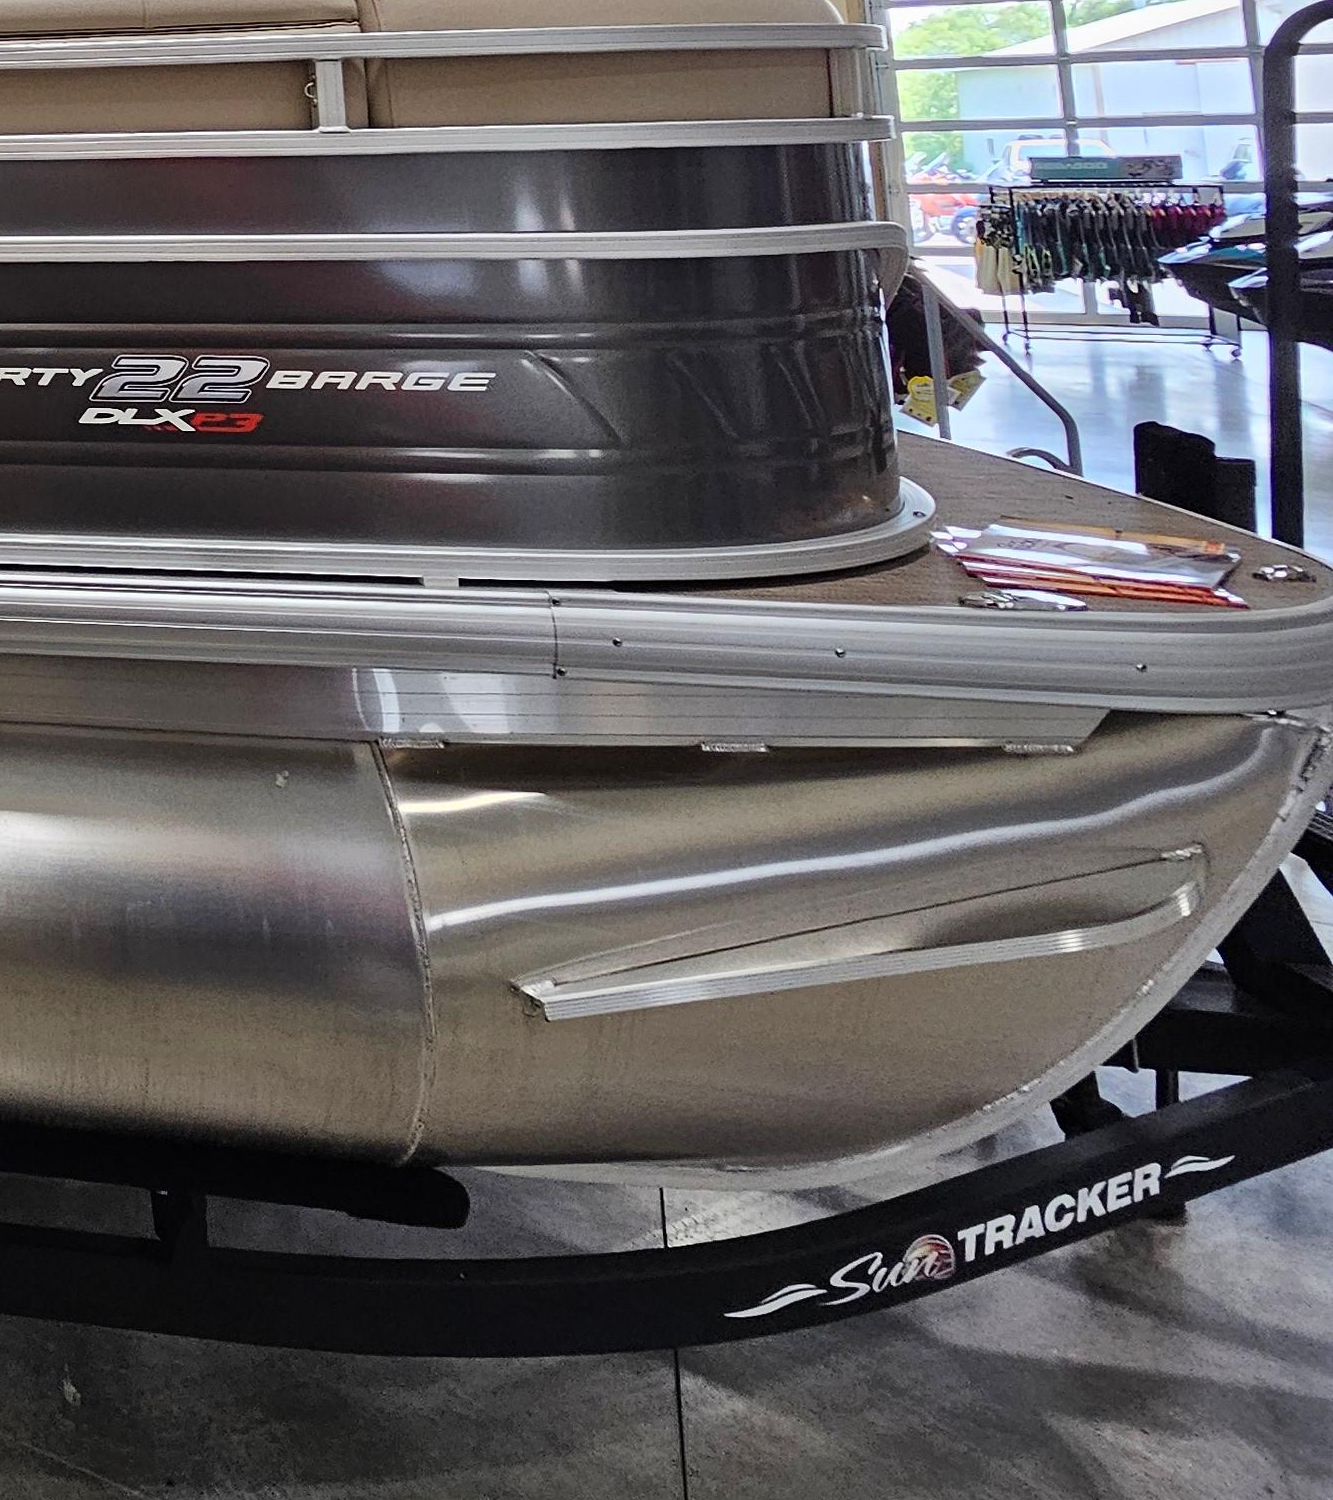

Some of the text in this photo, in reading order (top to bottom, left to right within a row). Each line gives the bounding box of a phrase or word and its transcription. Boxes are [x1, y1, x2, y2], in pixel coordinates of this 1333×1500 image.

[88, 354, 271, 404] 22
[265, 370, 497, 392] BARGE
[818, 1161, 1163, 1306] Sun TRACKER
